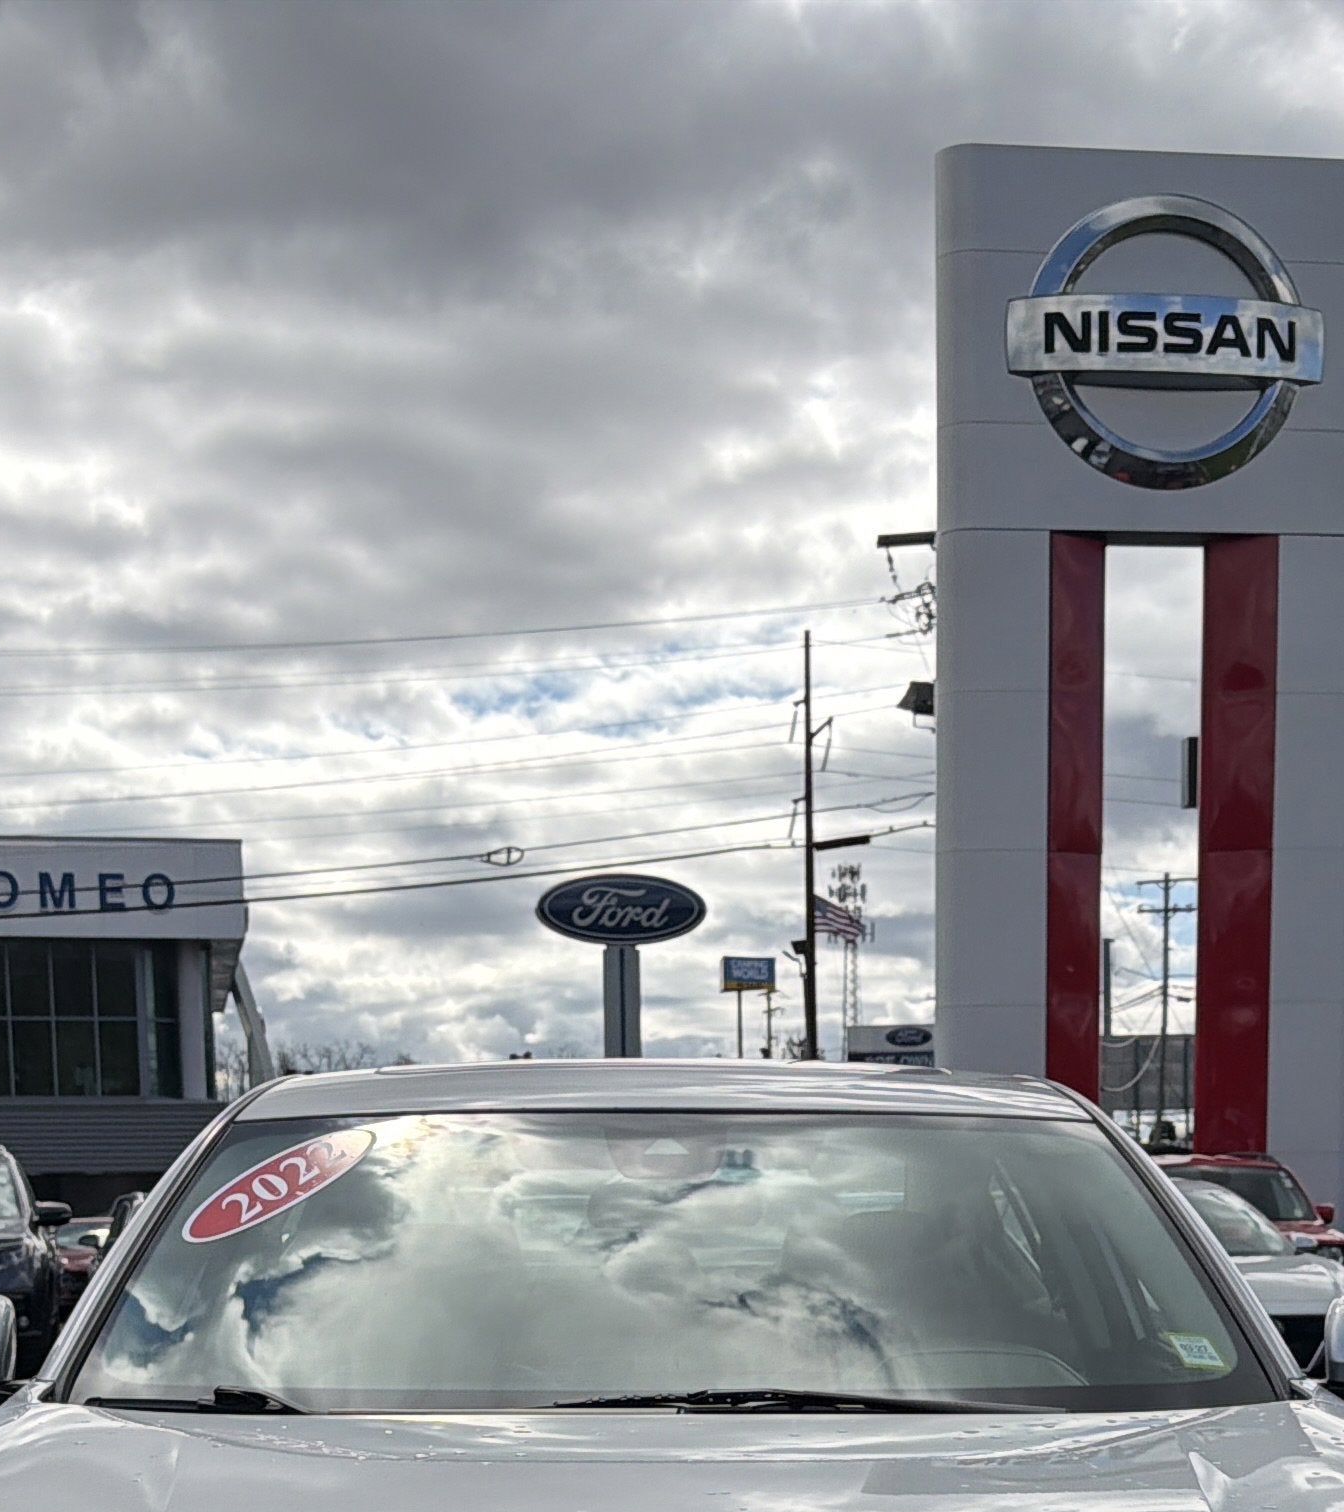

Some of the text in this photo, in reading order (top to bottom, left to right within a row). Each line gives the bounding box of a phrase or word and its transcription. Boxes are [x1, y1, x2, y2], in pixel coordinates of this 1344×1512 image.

[1043, 310, 1297, 363] NISSAN
[571, 885, 671, 928] Ford
[221, 1140, 348, 1224] 2022
